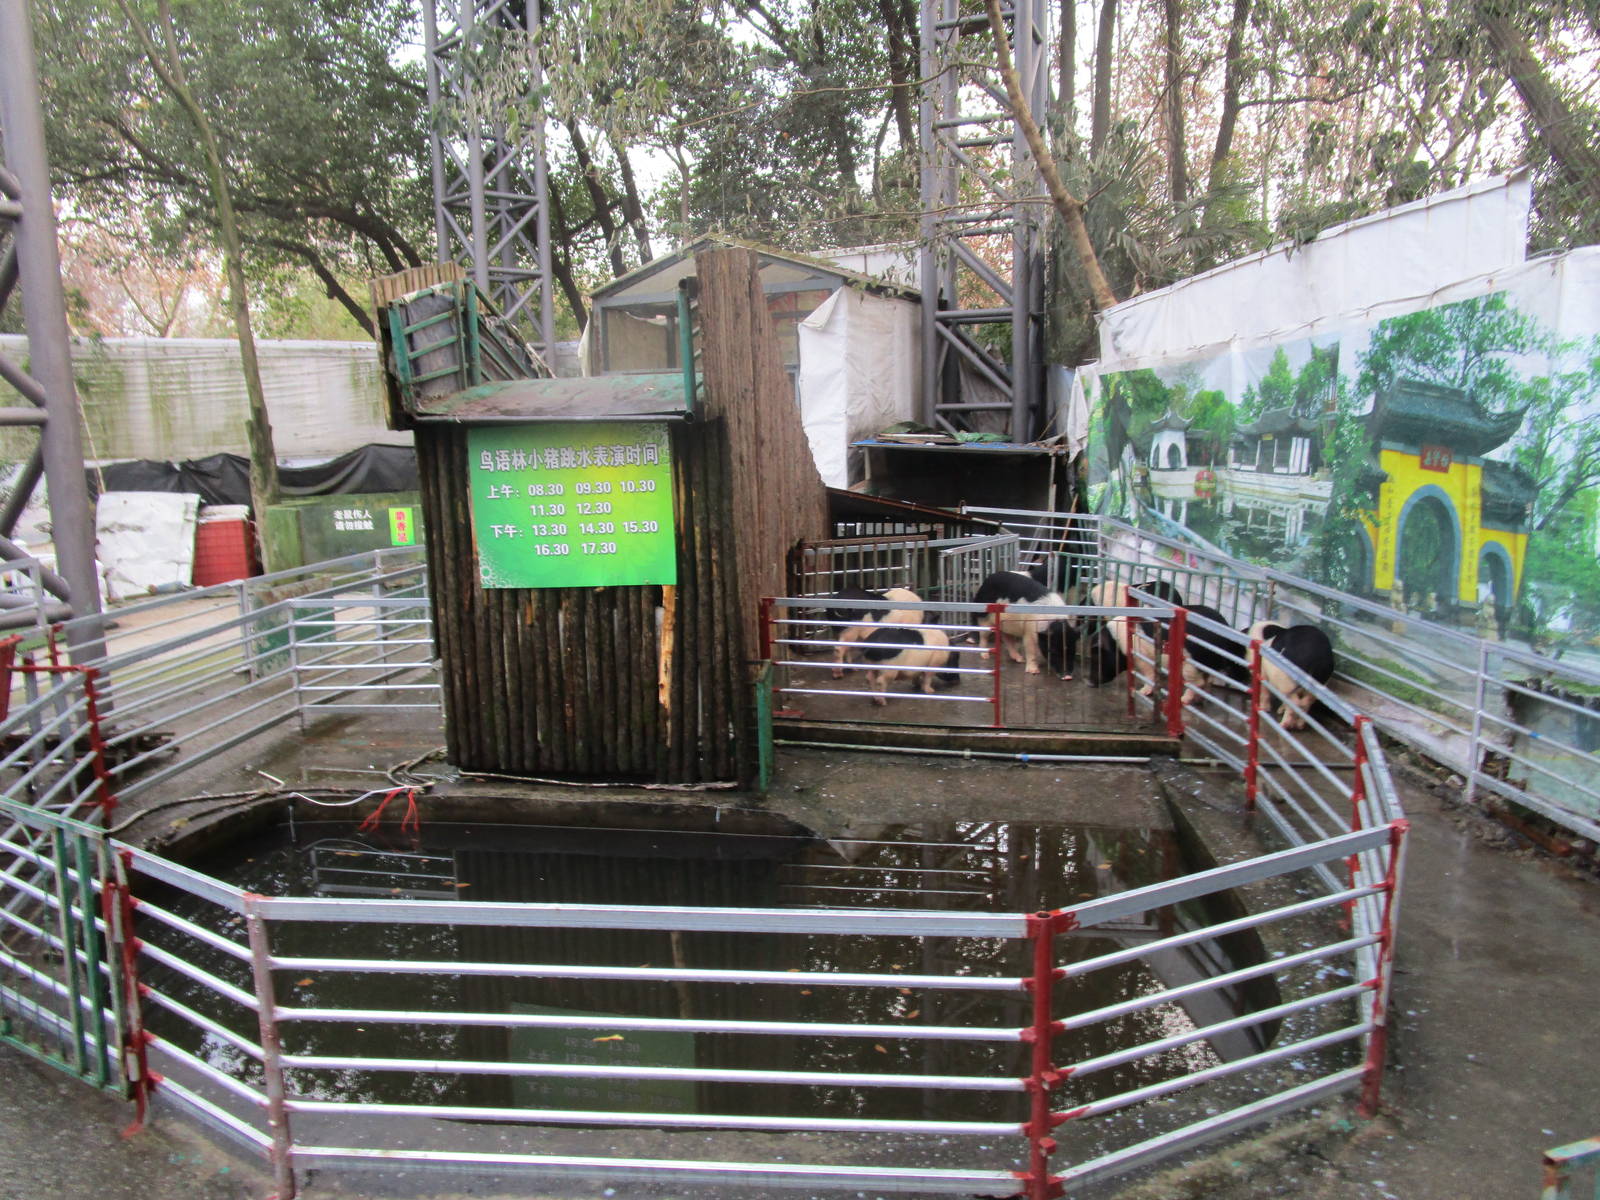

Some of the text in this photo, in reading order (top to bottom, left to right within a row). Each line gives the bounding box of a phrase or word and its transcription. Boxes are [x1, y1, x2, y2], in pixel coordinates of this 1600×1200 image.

[480, 443, 658, 471] 鸟语林小猪跳水表演时间
[528, 483, 564, 496] 08.30
[575, 482, 611, 494] 09.30
[620, 480, 655, 492] 10.30
[530, 502, 611, 516] 11.30 12.30
[532, 524, 567, 536] 13.30
[579, 522, 614, 534] 14.30
[623, 521, 658, 533] 15.30
[534, 542, 616, 555] 16.30 17.30
